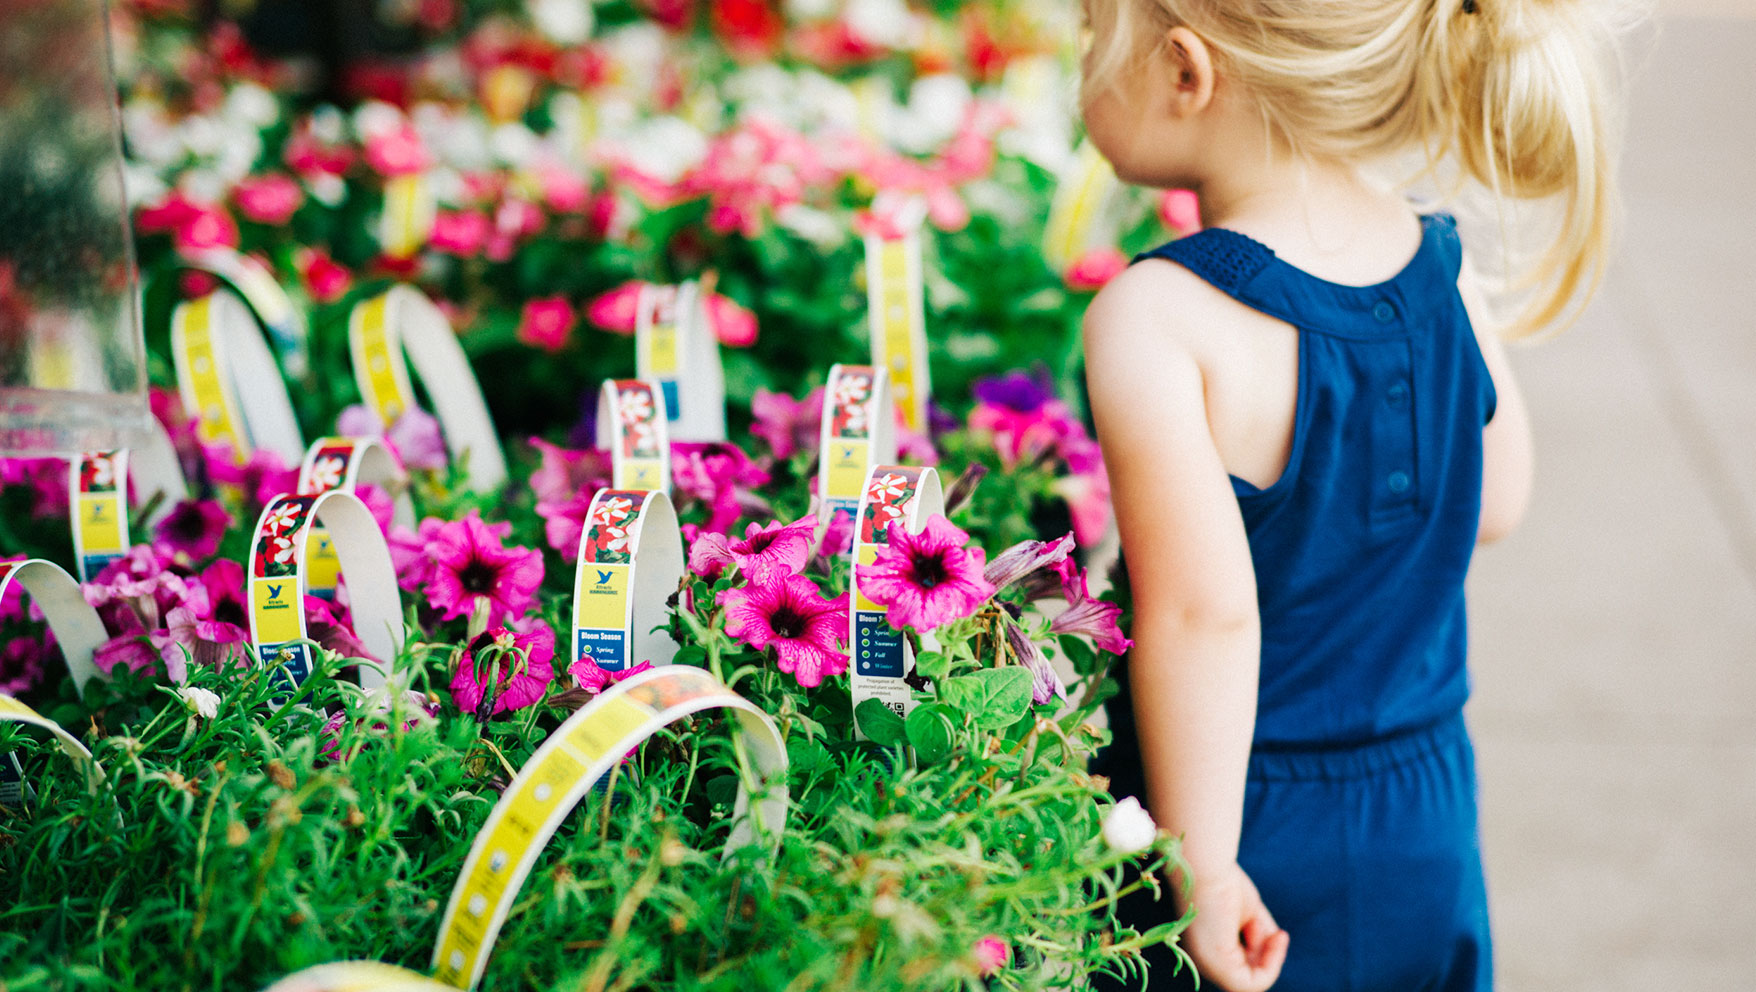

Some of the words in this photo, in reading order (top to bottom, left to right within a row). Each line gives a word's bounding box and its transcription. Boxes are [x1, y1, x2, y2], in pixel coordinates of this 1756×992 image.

[859, 614, 878, 622] Bloom
[581, 631, 599, 640] Bloom
[600, 632, 622, 640] Season
